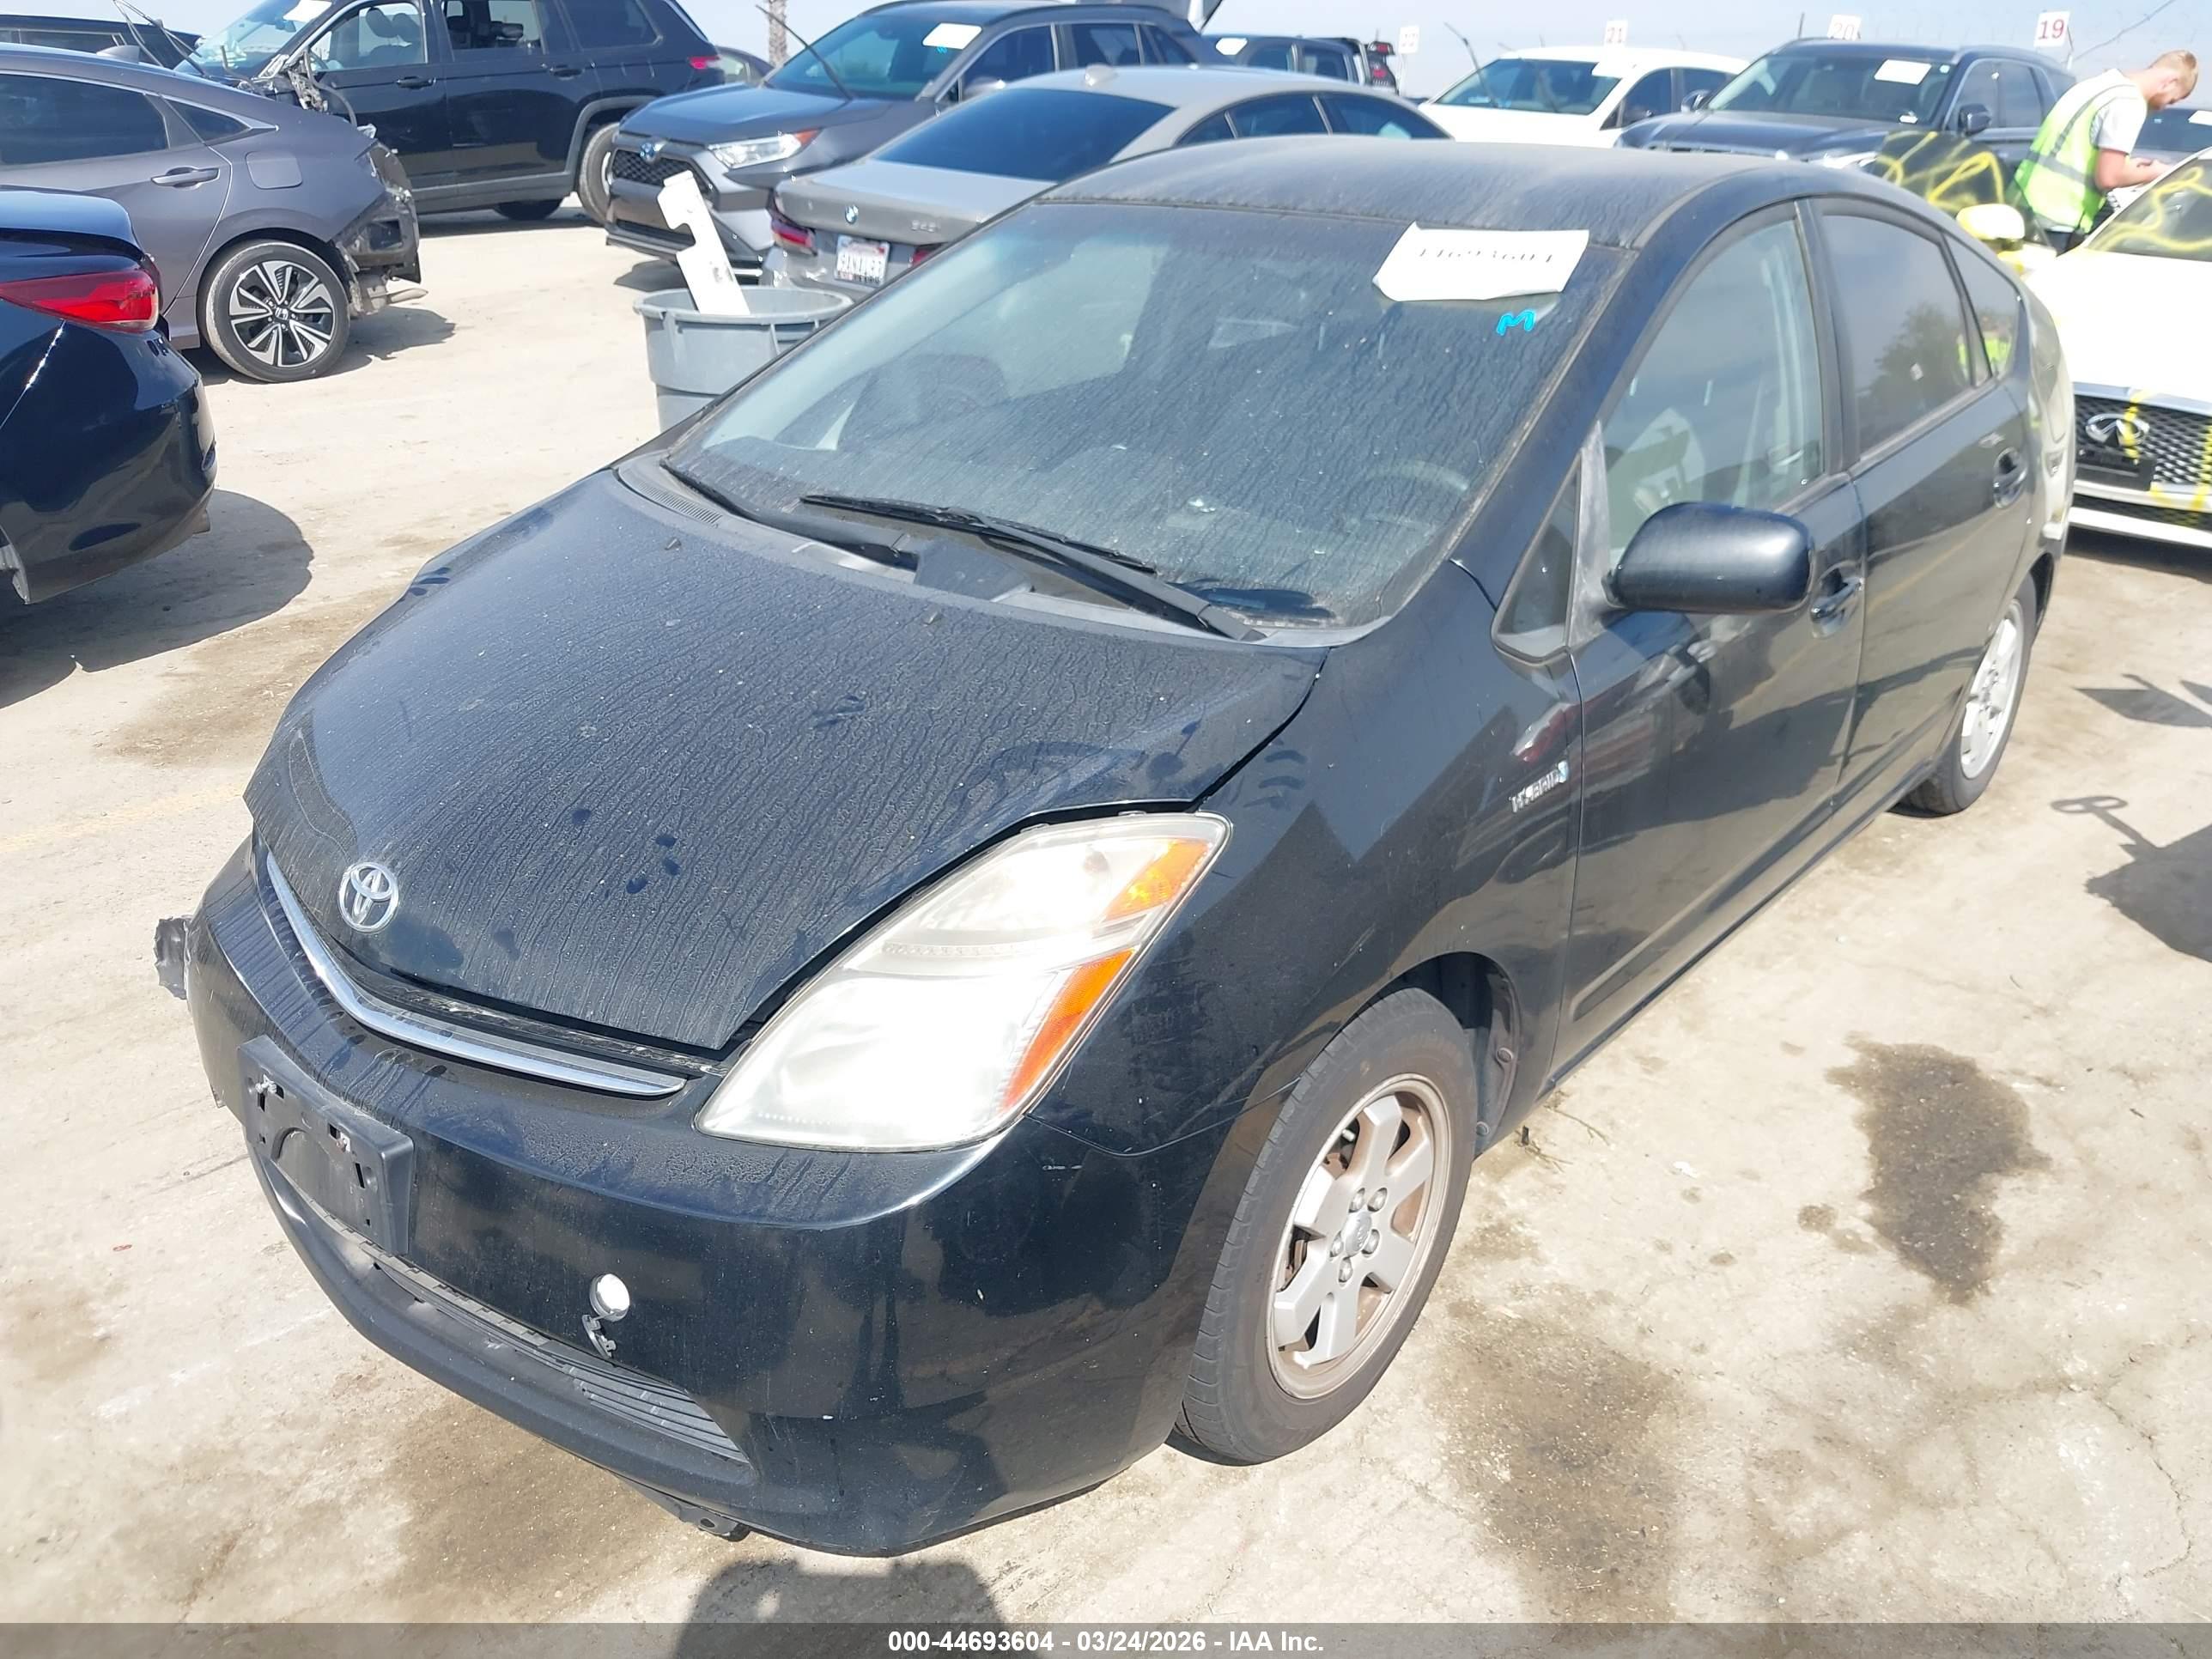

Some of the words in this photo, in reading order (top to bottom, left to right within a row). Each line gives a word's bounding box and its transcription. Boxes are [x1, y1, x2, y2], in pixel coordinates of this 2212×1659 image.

[1607, 27, 1623, 44] 21
[2038, 18, 2065, 40] 19
[1497, 309, 1537, 336] M
